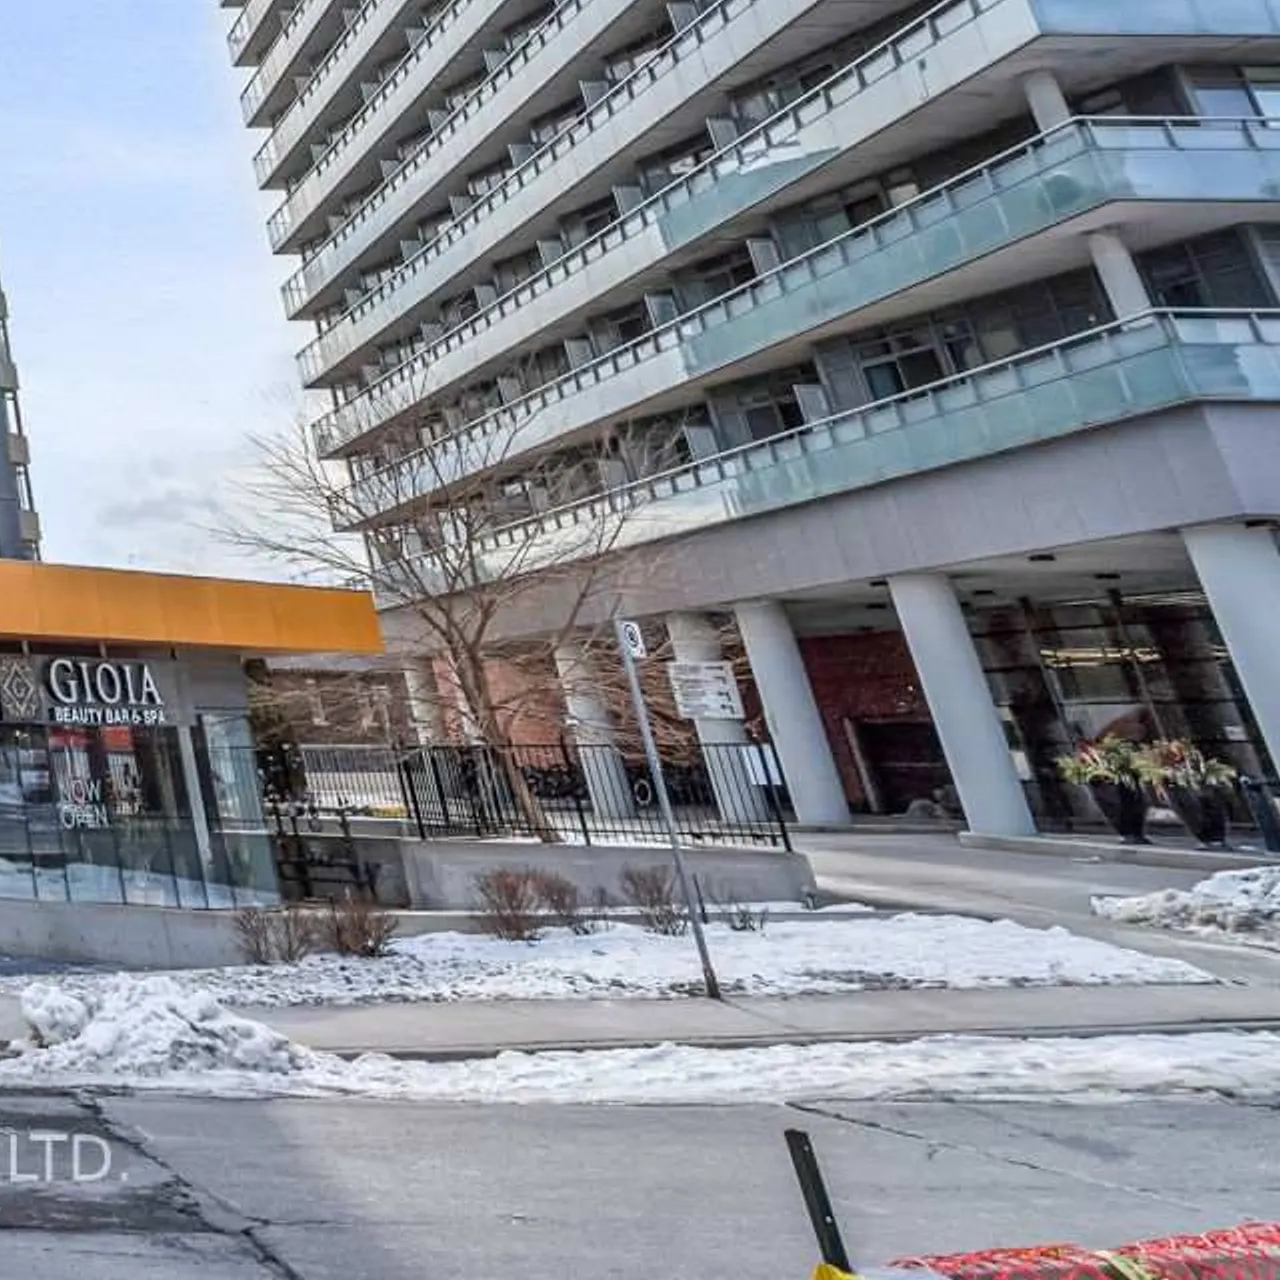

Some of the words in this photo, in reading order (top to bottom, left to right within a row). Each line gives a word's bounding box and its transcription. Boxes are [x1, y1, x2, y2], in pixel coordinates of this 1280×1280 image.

[50, 659, 164, 705] GIOIA
[55, 706, 102, 724] BEAUTY
[105, 707, 130, 724] BAR
[132, 708, 142, 725] &
[143, 709, 165, 726] SPA
[59, 780, 101, 803] NOW
[62, 805, 110, 829] OPEN
